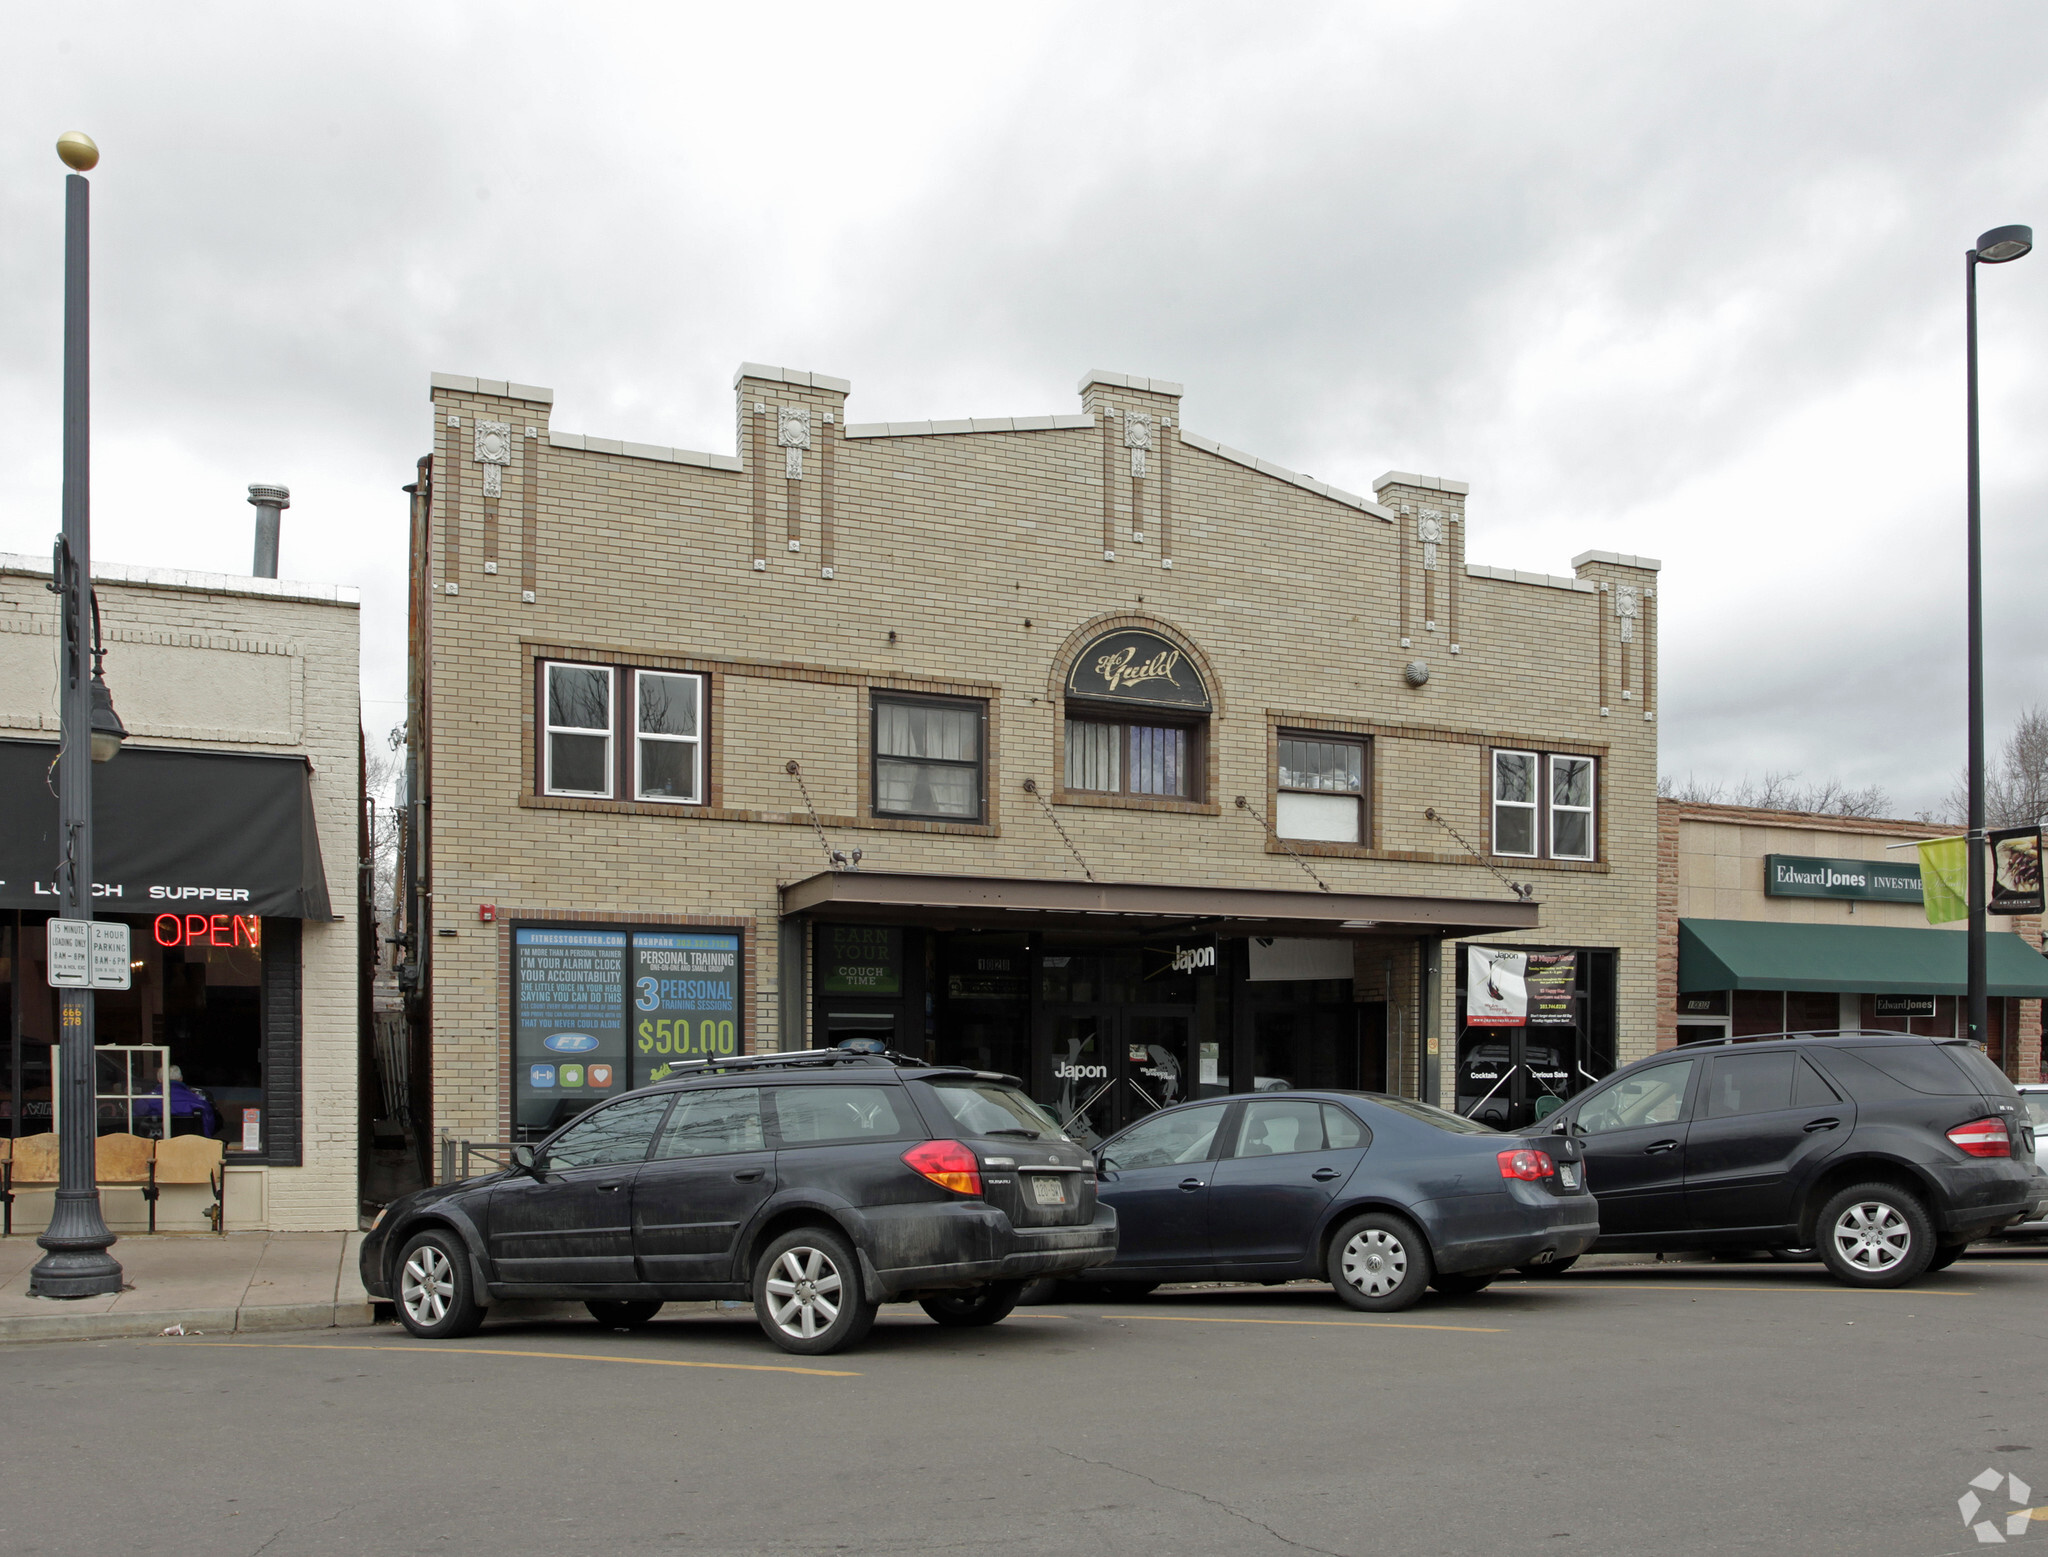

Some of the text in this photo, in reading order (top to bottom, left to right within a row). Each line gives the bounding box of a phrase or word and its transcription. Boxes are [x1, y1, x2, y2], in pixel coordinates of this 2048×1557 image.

[1104, 647, 1180, 691] Guild
[1826, 868, 1865, 887] Jones
[149, 886, 249, 901] SUPPER
[55, 924, 84, 934] 15 MINUTE
[155, 914, 259, 947] OPEN
[96, 930, 124, 939] 2 HOUR
[834, 928, 888, 943] EARN
[52, 938, 86, 947] LOADING ONLY
[633, 937, 673, 946] WASHPARK
[94, 943, 126, 952] PARKING
[834, 945, 889, 960] YOUR
[520, 948, 530, 956] I'M
[549, 949, 564, 957] THAN
[599, 950, 621, 958] TRAINER
[1495, 952, 1518, 960] Japon
[520, 957, 621, 970] I'M YOUR ALARM CLOCK
[640, 951, 734, 966] PERSONAL TRAINING
[1172, 945, 1215, 975] Japon
[521, 970, 621, 982] YOUR ACCOUNTABILITY
[839, 967, 884, 976] COUCH
[846, 976, 876, 986] TIME
[521, 983, 532, 991] THE
[535, 983, 554, 991] LITTLE
[556, 984, 574, 992] VOICE
[577, 984, 584, 992] IN
[587, 984, 603, 992] YOUR
[521, 992, 622, 1002] SAYING YOU CAN DO THIS
[636, 976, 733, 1011] 3 PERSONAL
[662, 1000, 732, 1011] TRAINING SESSIONS
[1907, 1000, 1932, 1010] Jones
[63, 1017, 81, 1026] 278
[522, 1019, 620, 1028] THAT YOU NEVER COULD ALONE
[638, 1019, 734, 1054] $50.00
[557, 1037, 587, 1047] FT
[1054, 1062, 1107, 1081] Japon
